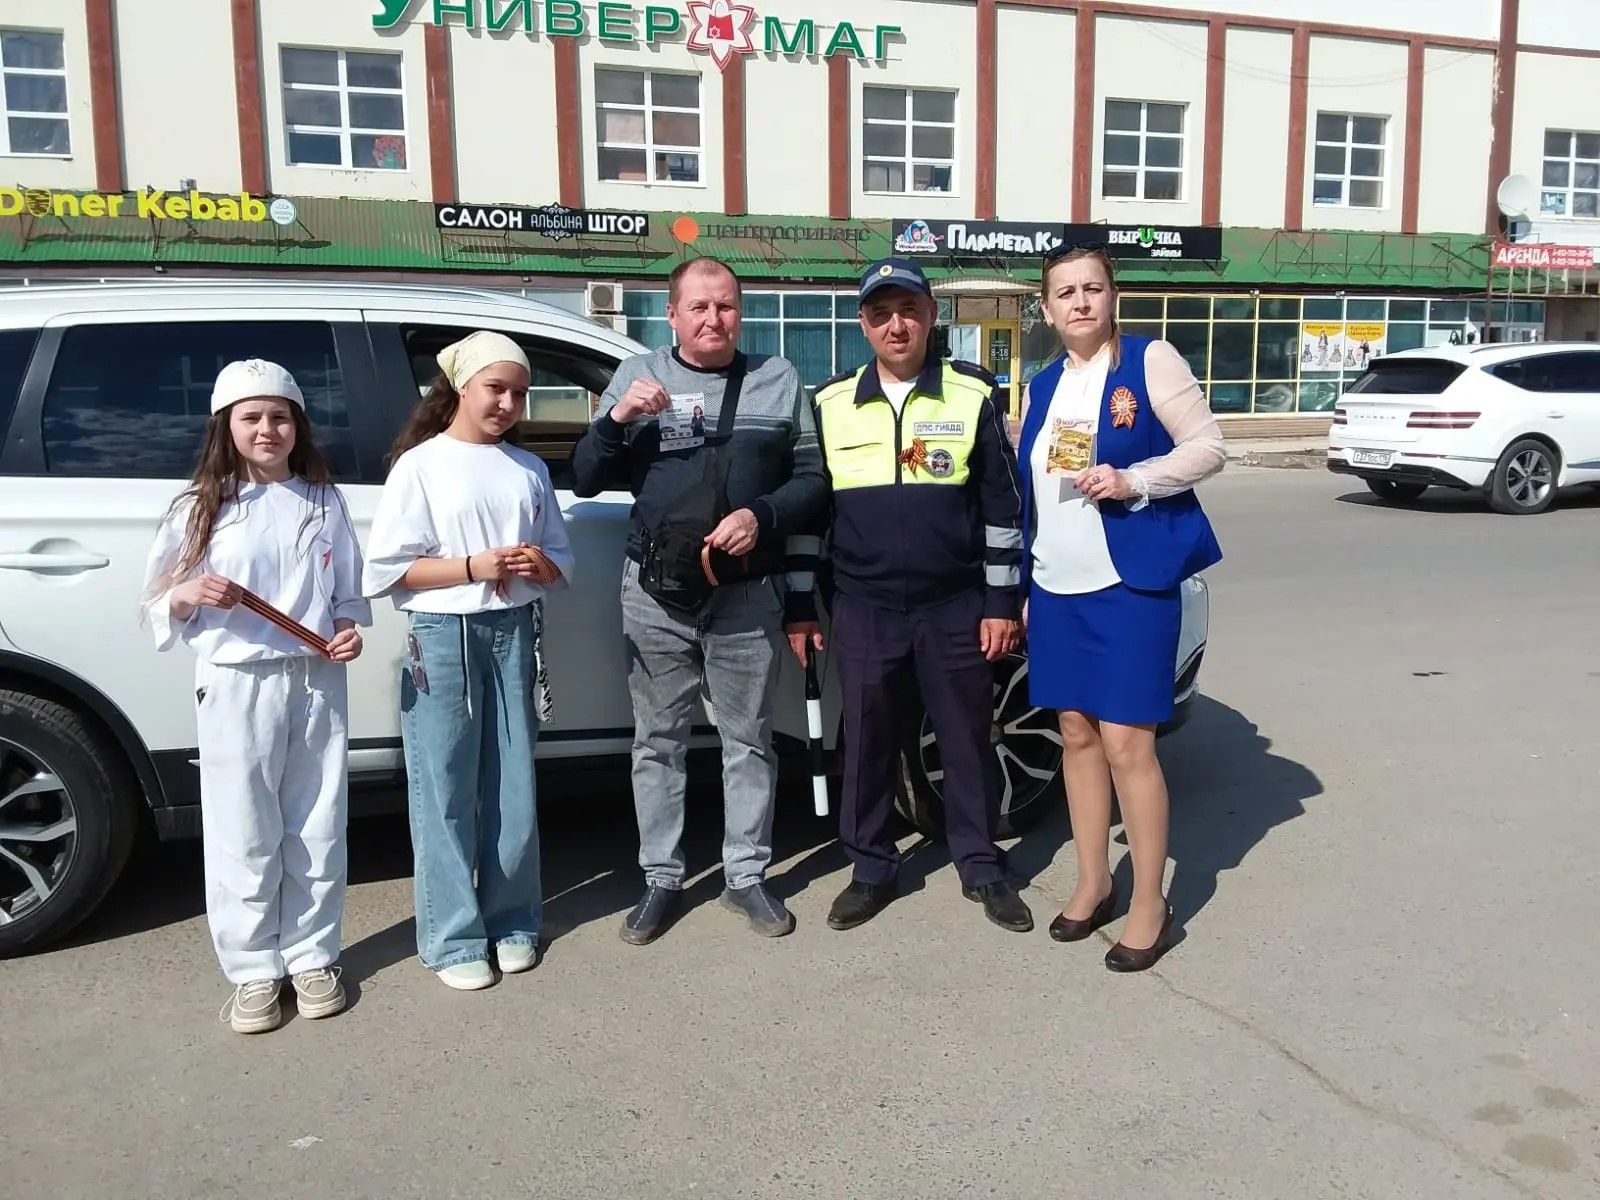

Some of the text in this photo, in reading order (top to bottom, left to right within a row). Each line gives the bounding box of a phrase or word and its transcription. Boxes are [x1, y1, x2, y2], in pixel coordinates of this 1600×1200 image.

[138, 190, 267, 222] Kebab
[439, 207, 646, 233] САЛОН АЛЬБИНА ШТОР
